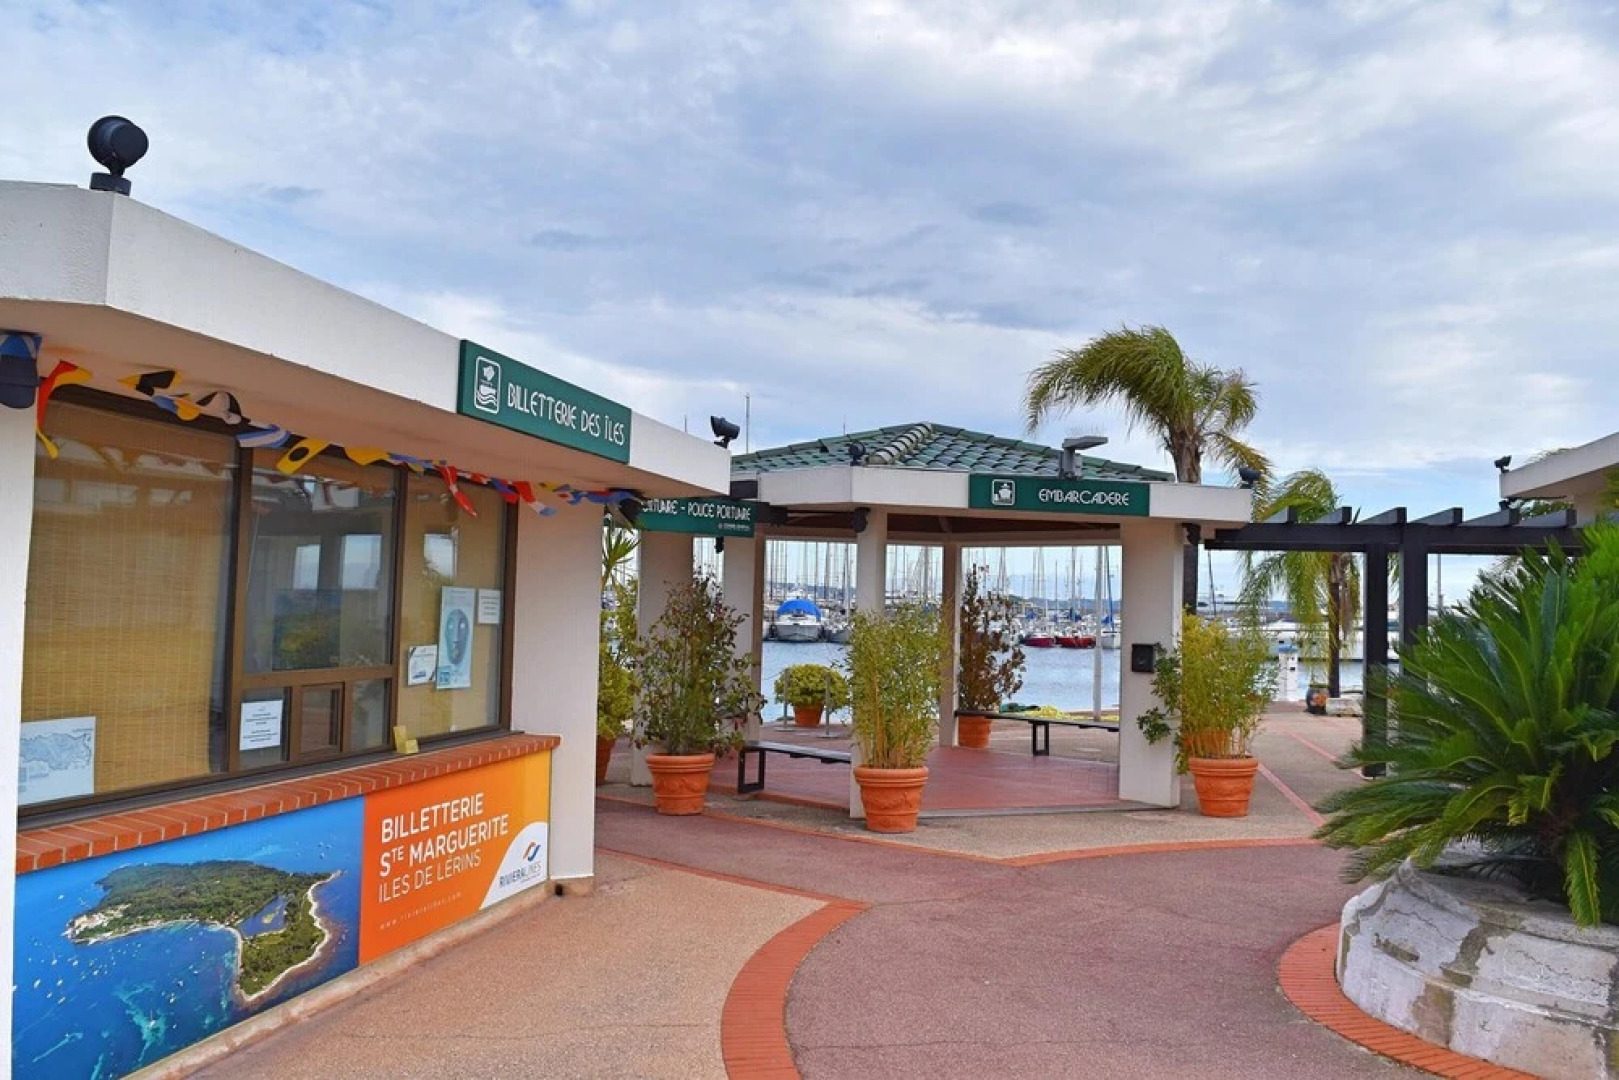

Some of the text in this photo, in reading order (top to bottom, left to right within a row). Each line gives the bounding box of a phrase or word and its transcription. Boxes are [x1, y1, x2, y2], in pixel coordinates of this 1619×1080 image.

[507, 382, 577, 430] BILLETTERIE
[580, 410, 600, 438] DES
[716, 505, 751, 521] PORTUAIRE
[1038, 488, 1130, 506] EMBARCADERE
[381, 792, 485, 844] BILLETTERIE
[409, 813, 509, 867] MARGUERITE
[378, 848, 482, 904] ILES DE LÉRINS
